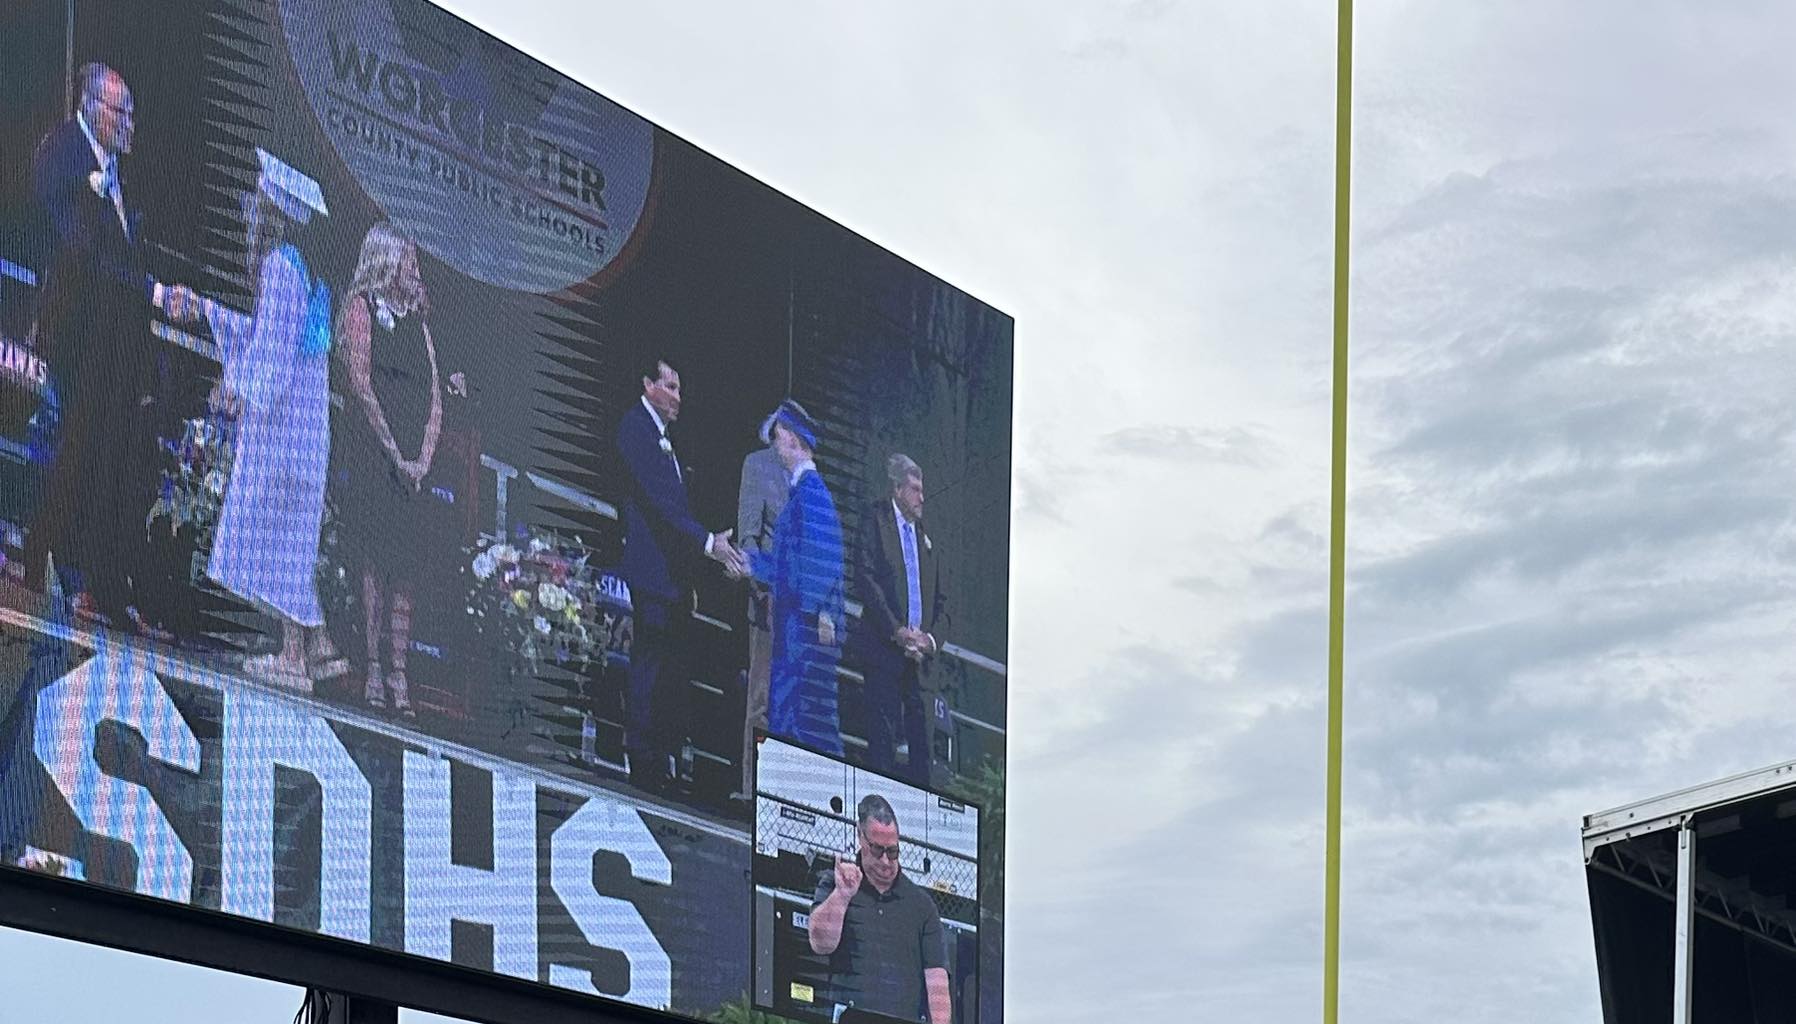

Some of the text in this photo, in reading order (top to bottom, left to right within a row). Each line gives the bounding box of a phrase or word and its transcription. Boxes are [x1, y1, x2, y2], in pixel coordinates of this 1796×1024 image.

[326, 107, 606, 254] COUNTY PUBLIC SCHOOLS
[327, 30, 607, 212] WORCESTER
[32, 640, 672, 1011] SDHS
